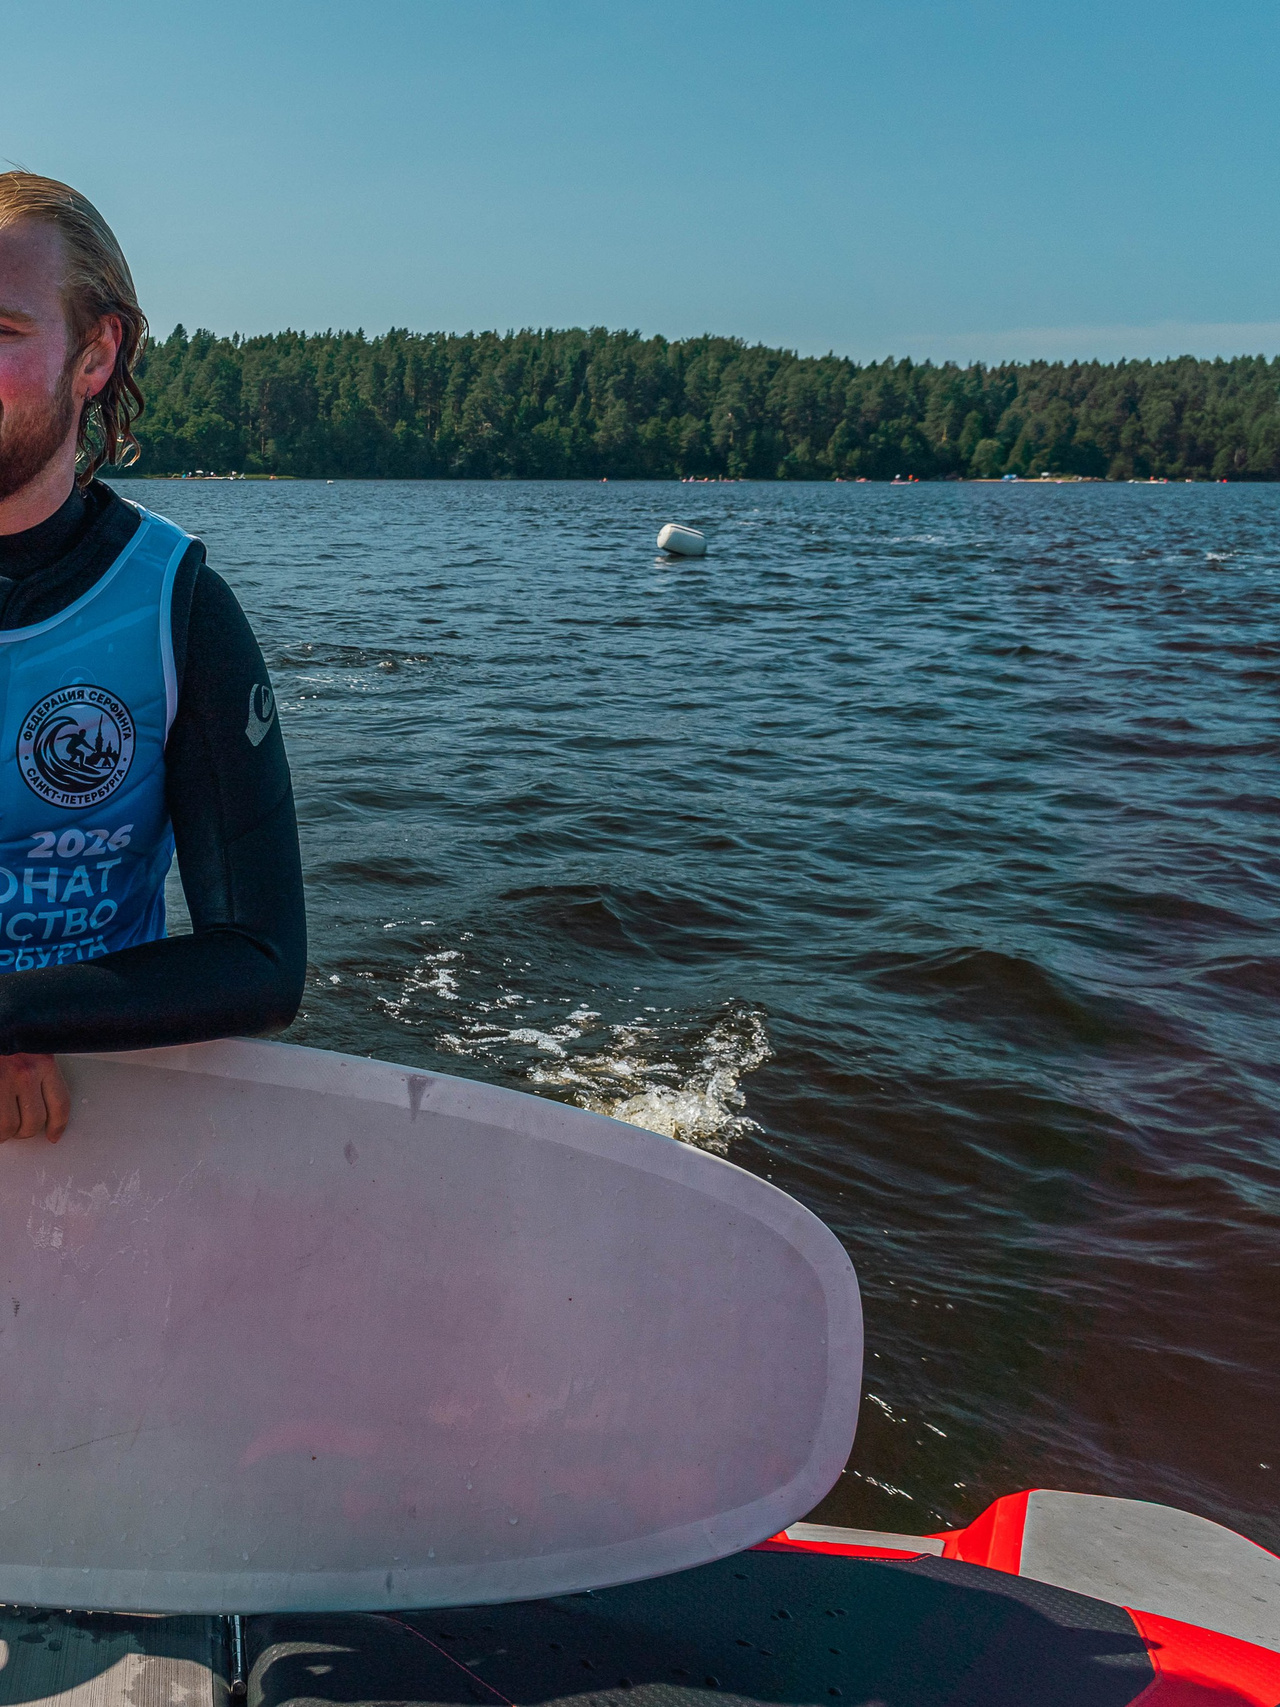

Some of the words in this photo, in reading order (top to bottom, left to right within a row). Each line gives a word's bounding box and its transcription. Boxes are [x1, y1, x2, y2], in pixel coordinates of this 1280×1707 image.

[23, 689, 85, 741] ФЕДЕРАЦИЯ
[88, 690, 132, 741] СЕРФИНГА
[26, 767, 126, 805] САНКТ-ПЕТЕРБУРГА
[27, 823, 134, 859] 2026
